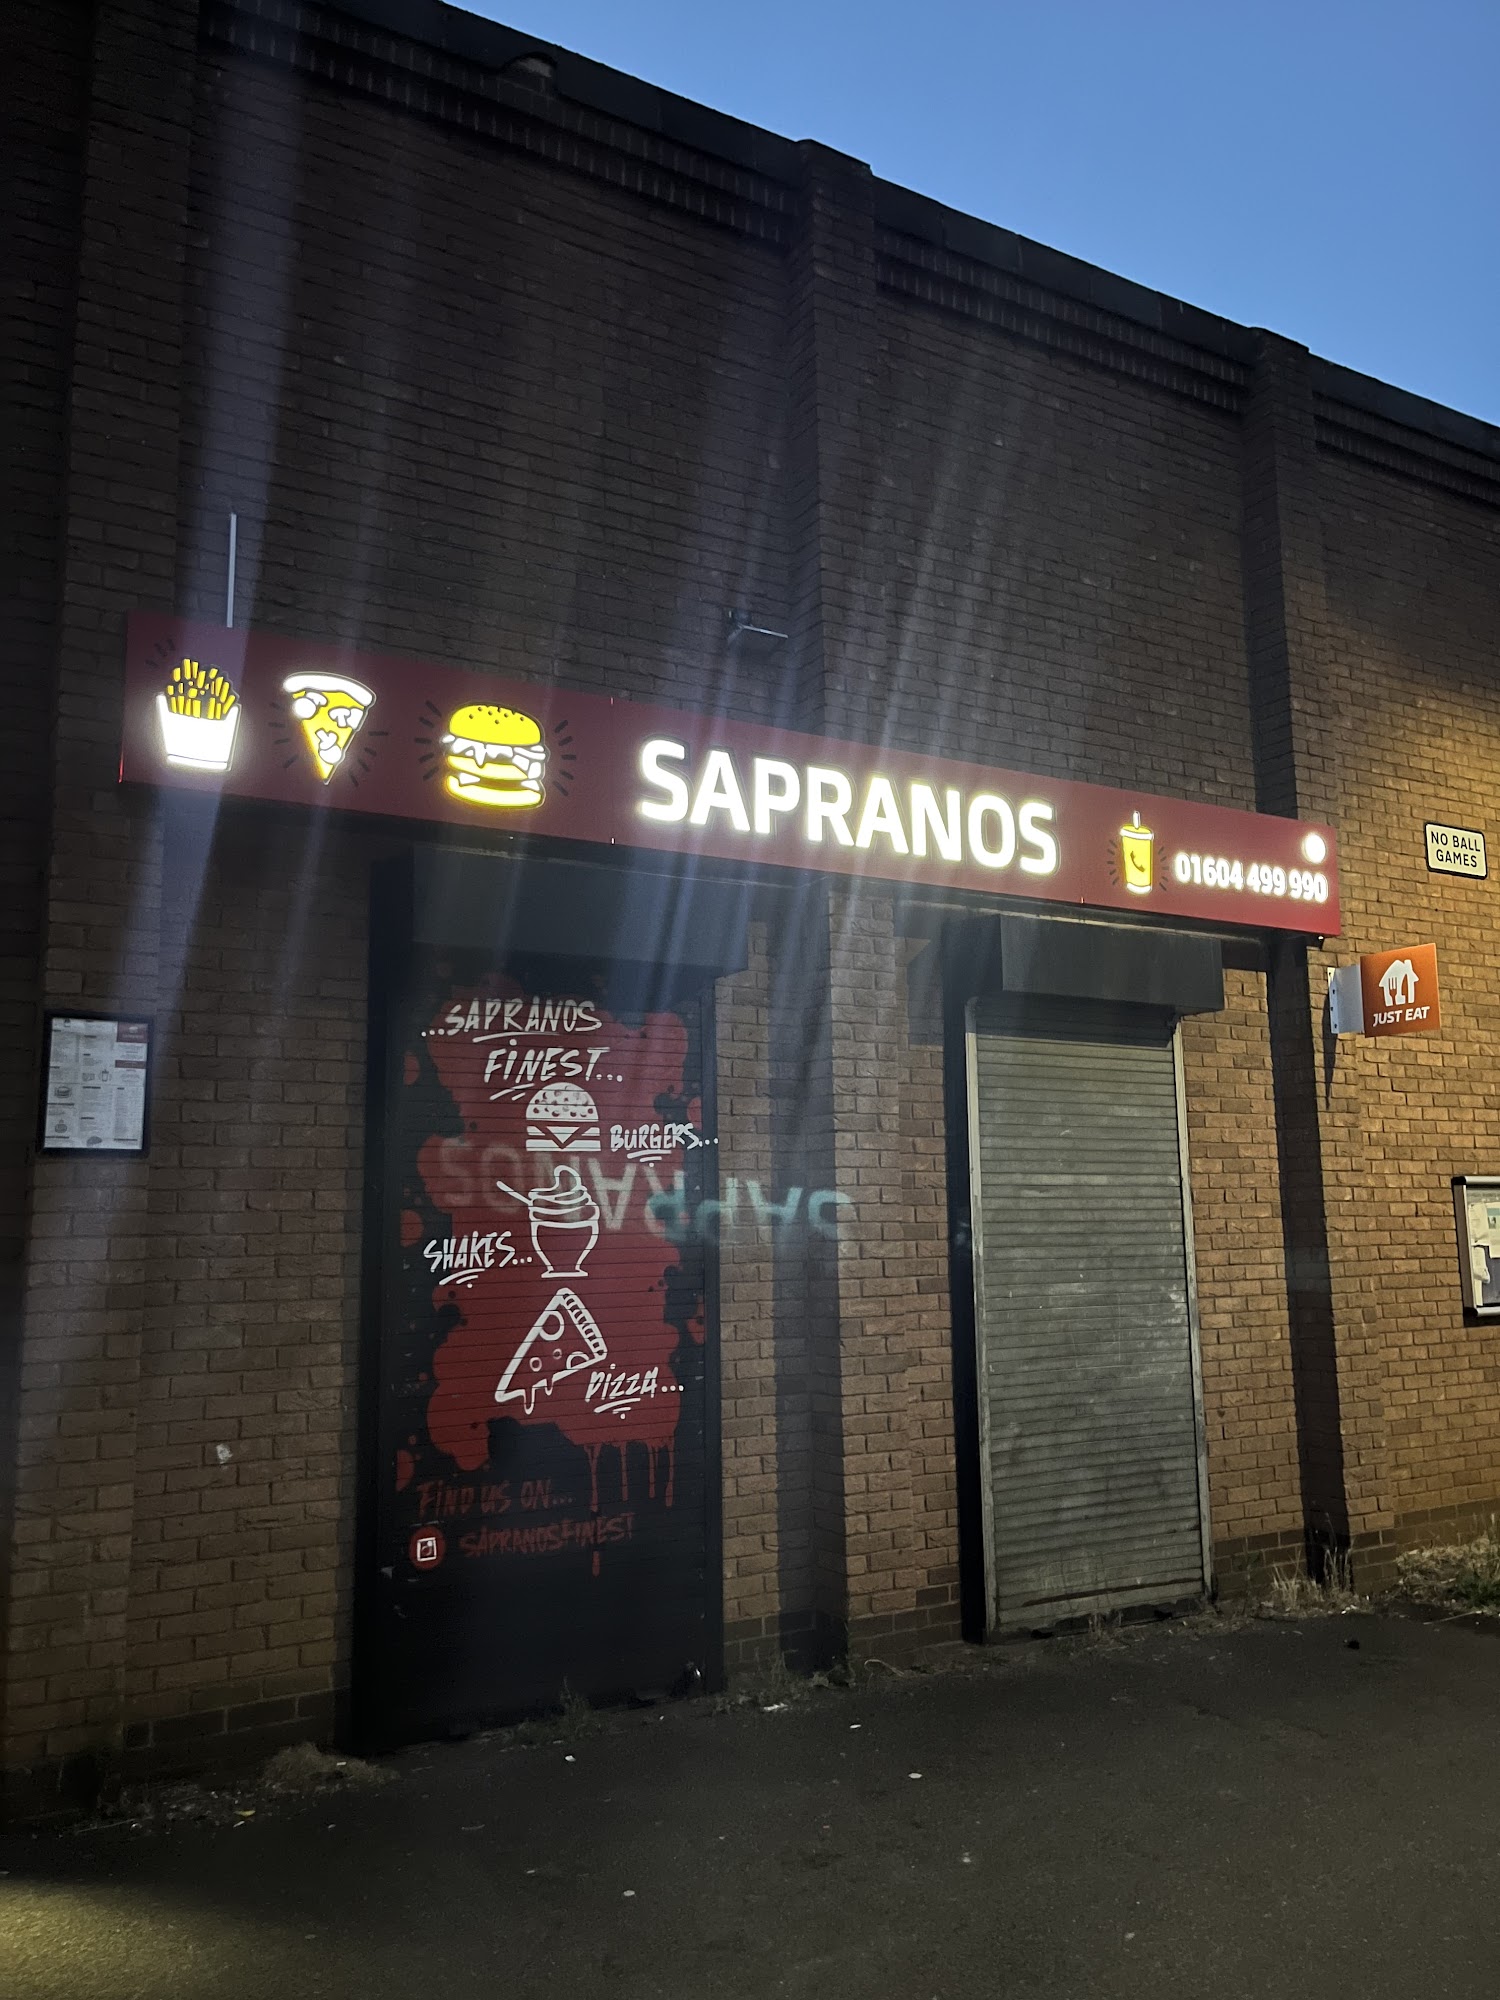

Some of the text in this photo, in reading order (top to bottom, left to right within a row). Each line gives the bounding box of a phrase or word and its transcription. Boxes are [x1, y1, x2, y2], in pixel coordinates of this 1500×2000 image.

[640, 739, 1060, 875] SAPRANOS
[1431, 831, 1481, 852] NO BALL
[1436, 849, 1478, 868] GAMES
[1175, 852, 1328, 903] 01604 499 990
[1372, 1006, 1430, 1028] JUST EAT
